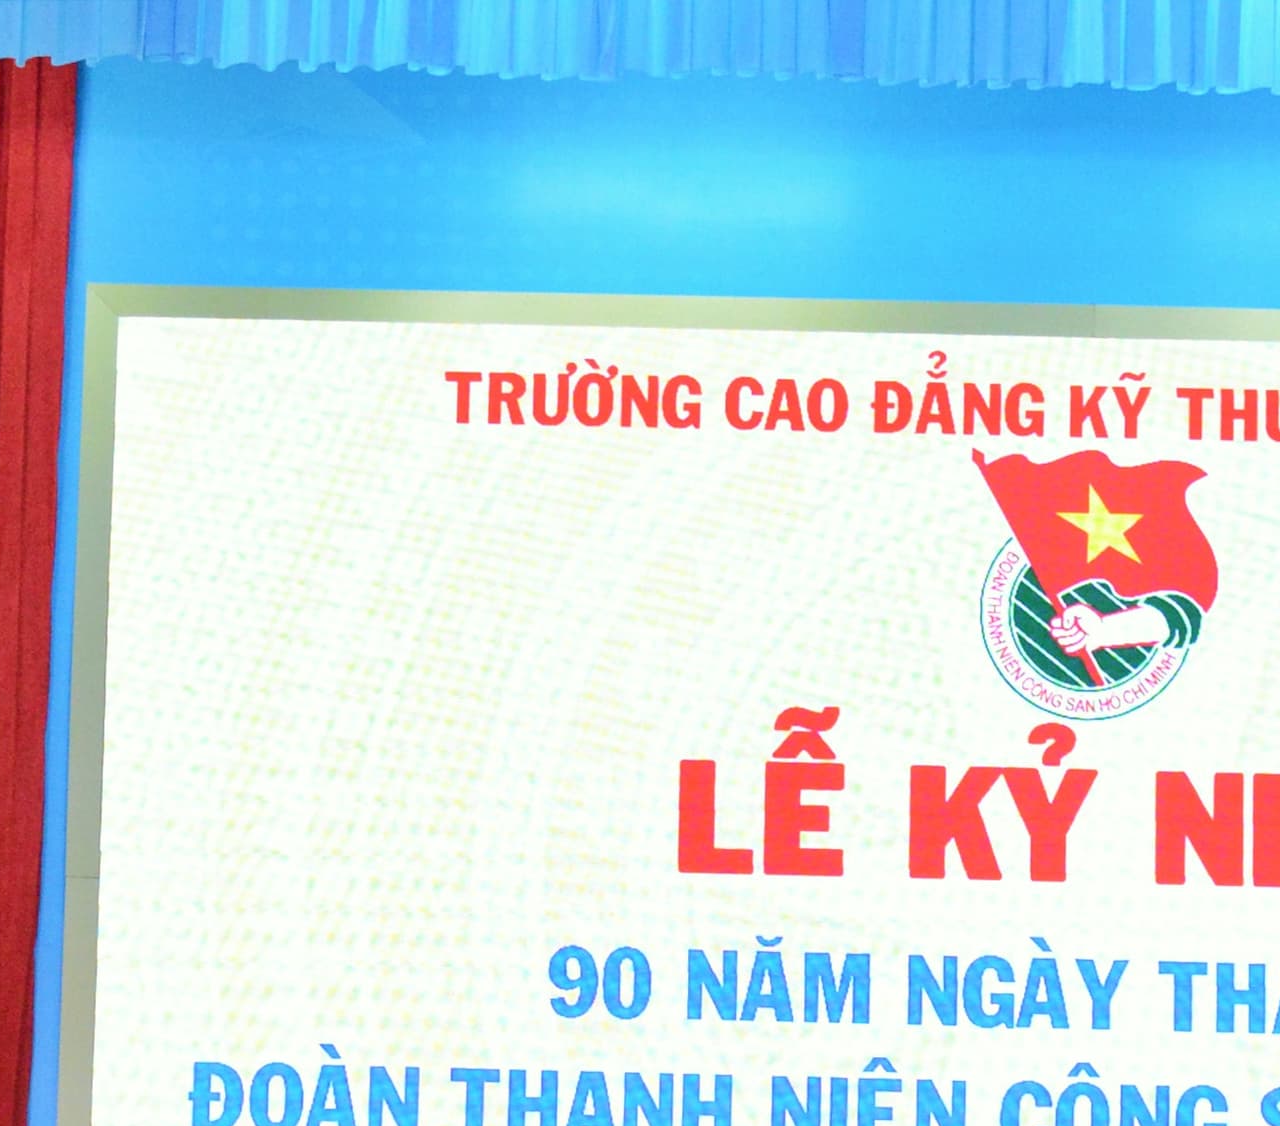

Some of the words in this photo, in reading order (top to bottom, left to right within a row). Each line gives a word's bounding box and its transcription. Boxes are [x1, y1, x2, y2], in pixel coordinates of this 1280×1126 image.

[445, 359, 702, 428] TRƯỜNG
[725, 377, 848, 432] CAO
[871, 351, 1044, 437] ĐẲNG
[1070, 372, 1151, 439] KỸ
[678, 707, 845, 876] LỄ
[909, 723, 1098, 882] KỶ
[548, 945, 652, 1020] 90
[687, 936, 871, 1024] NĂM
[907, 937, 1128, 1030] NGÀY
